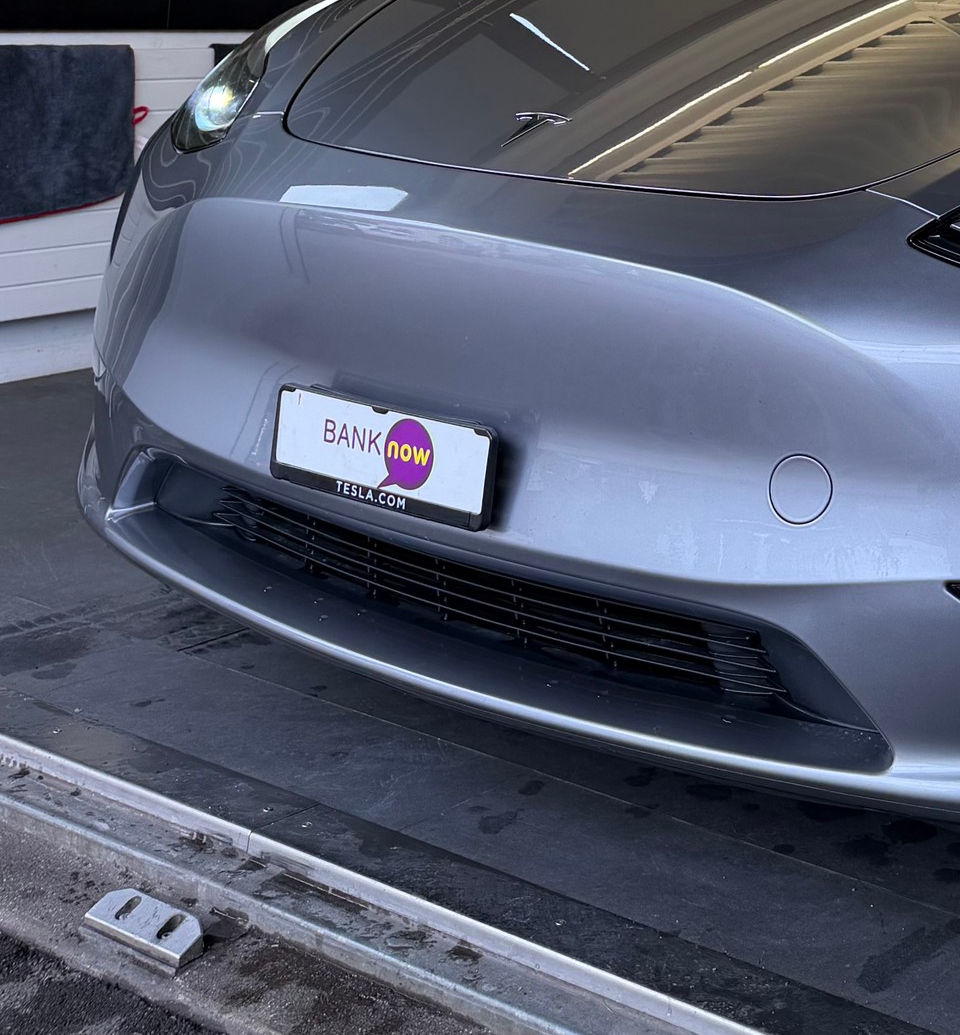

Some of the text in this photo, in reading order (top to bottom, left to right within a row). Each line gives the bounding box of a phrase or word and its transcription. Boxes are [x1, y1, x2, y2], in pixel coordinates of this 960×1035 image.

[323, 418, 431, 467] BANK now
[335, 480, 407, 510] TESLA.COM
